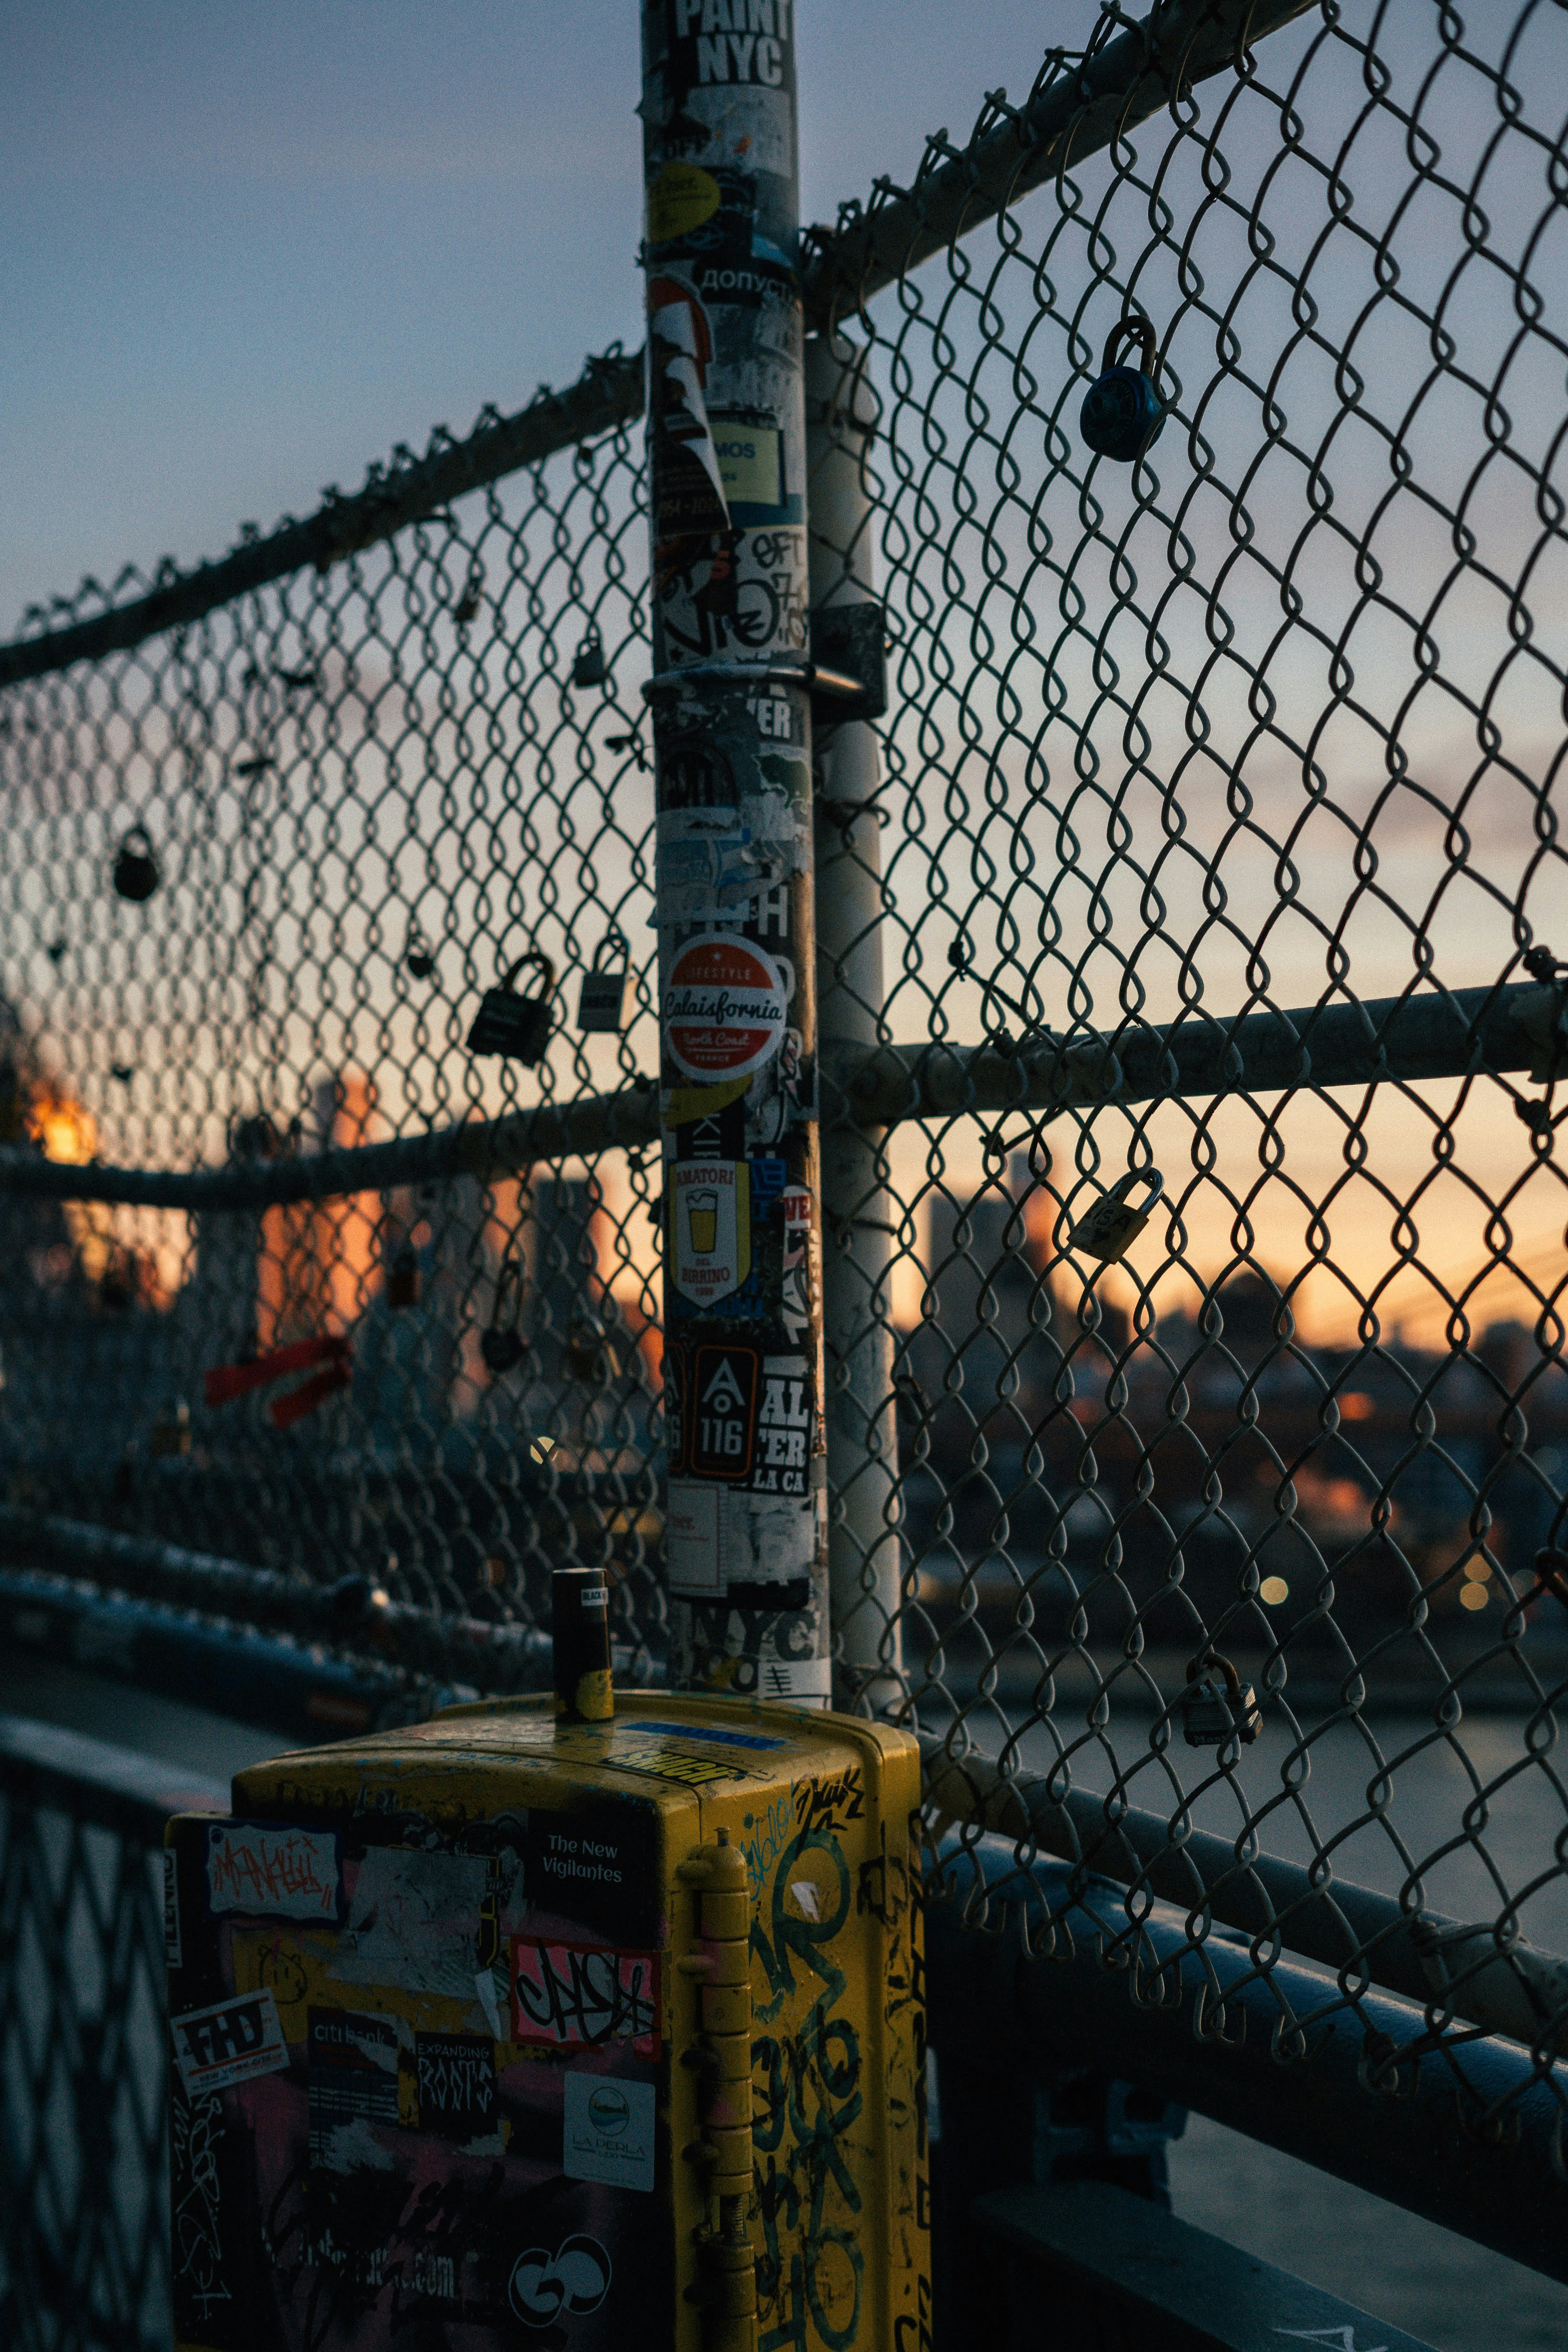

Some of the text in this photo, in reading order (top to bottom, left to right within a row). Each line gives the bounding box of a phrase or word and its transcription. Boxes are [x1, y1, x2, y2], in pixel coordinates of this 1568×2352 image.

[676, 0, 789, 39] PAINT
[696, 34, 783, 86] NYC
[685, 966, 751, 981] LIFESTYLE
[665, 990, 783, 1024] Calaisfornia
[676, 1169, 733, 1186] AMATORI
[759, 1379, 809, 1428] AL
[700, 1417, 744, 1456] 116
[752, 1469, 778, 1490] LA
[547, 1834, 618, 1860] The New
[543, 1857, 622, 1883] Vigilantes
[418, 2042, 490, 2059] EXPANDING
